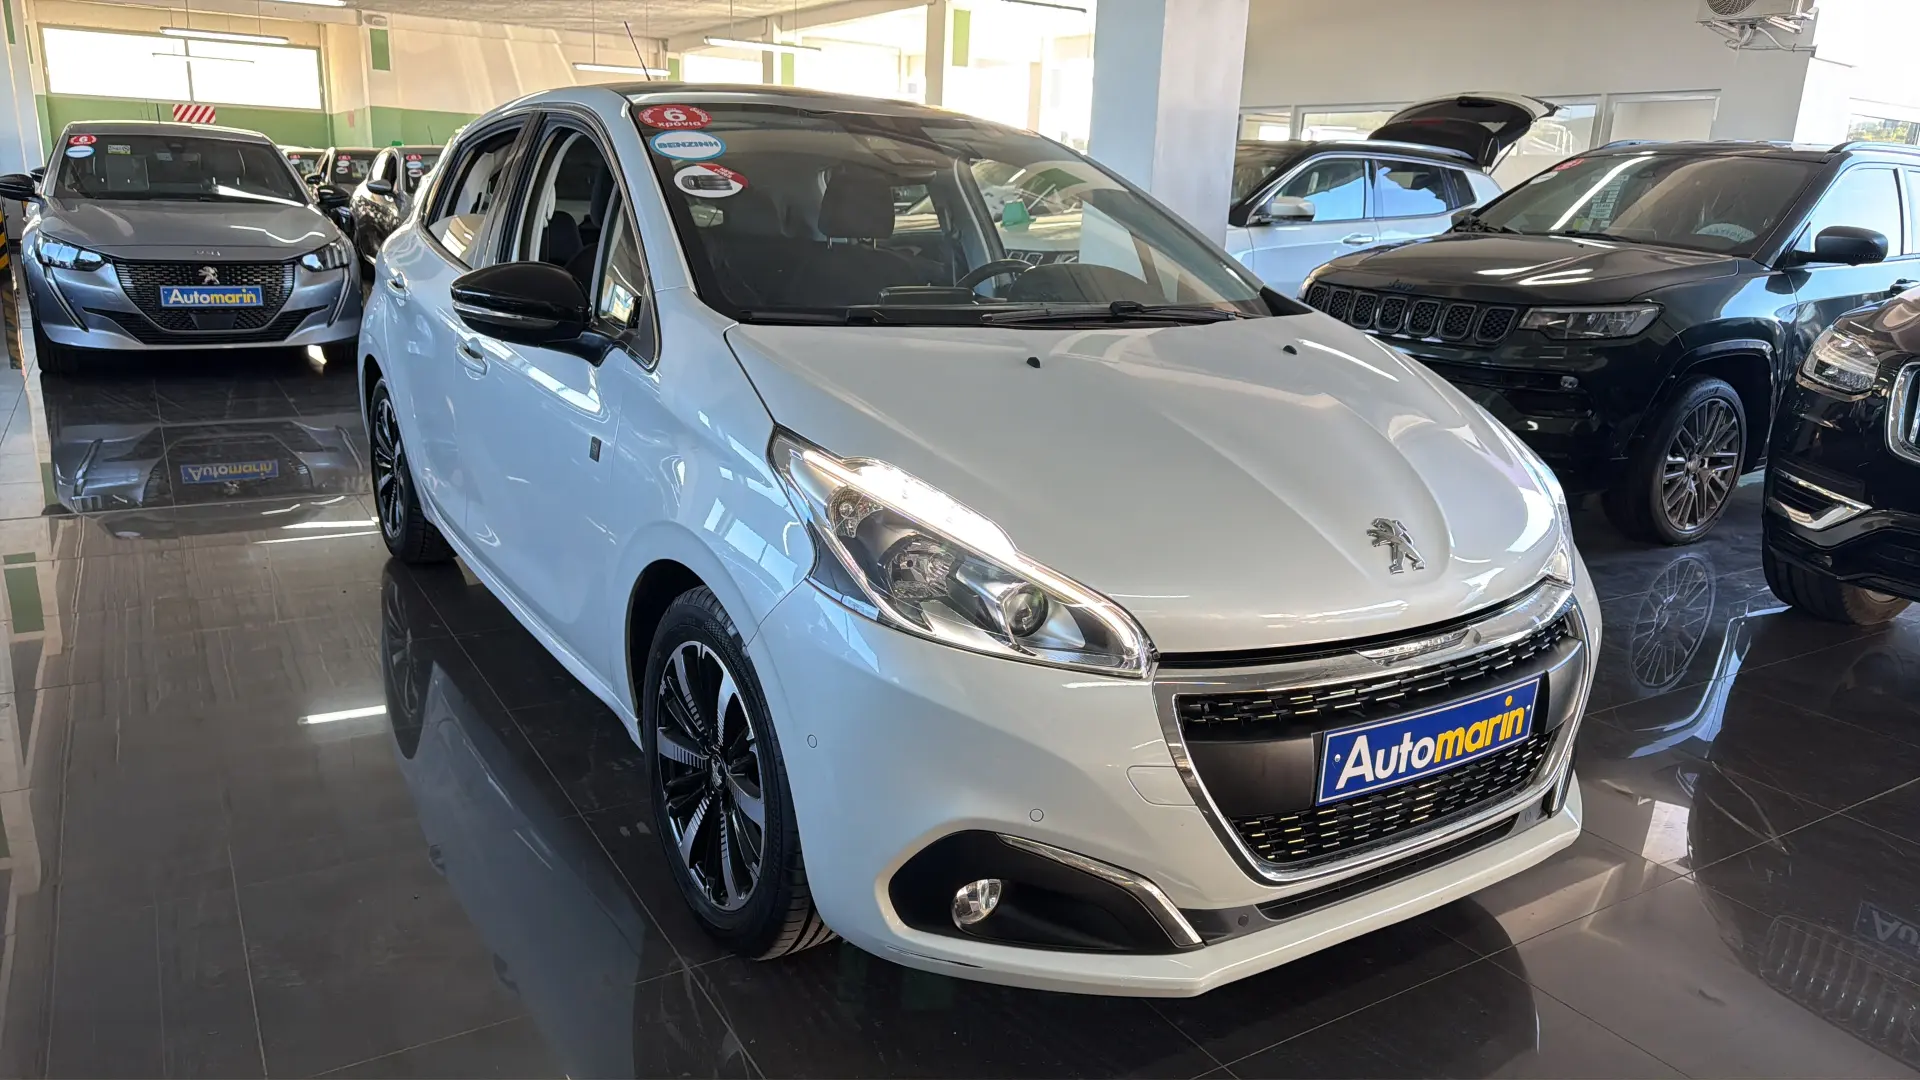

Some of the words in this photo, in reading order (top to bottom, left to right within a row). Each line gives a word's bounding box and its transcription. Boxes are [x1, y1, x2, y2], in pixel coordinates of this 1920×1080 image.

[664, 109, 687, 122] 6
[657, 120, 702, 128] χρόνια
[168, 288, 257, 304] Automarin
[1335, 695, 1525, 790] Automarin
